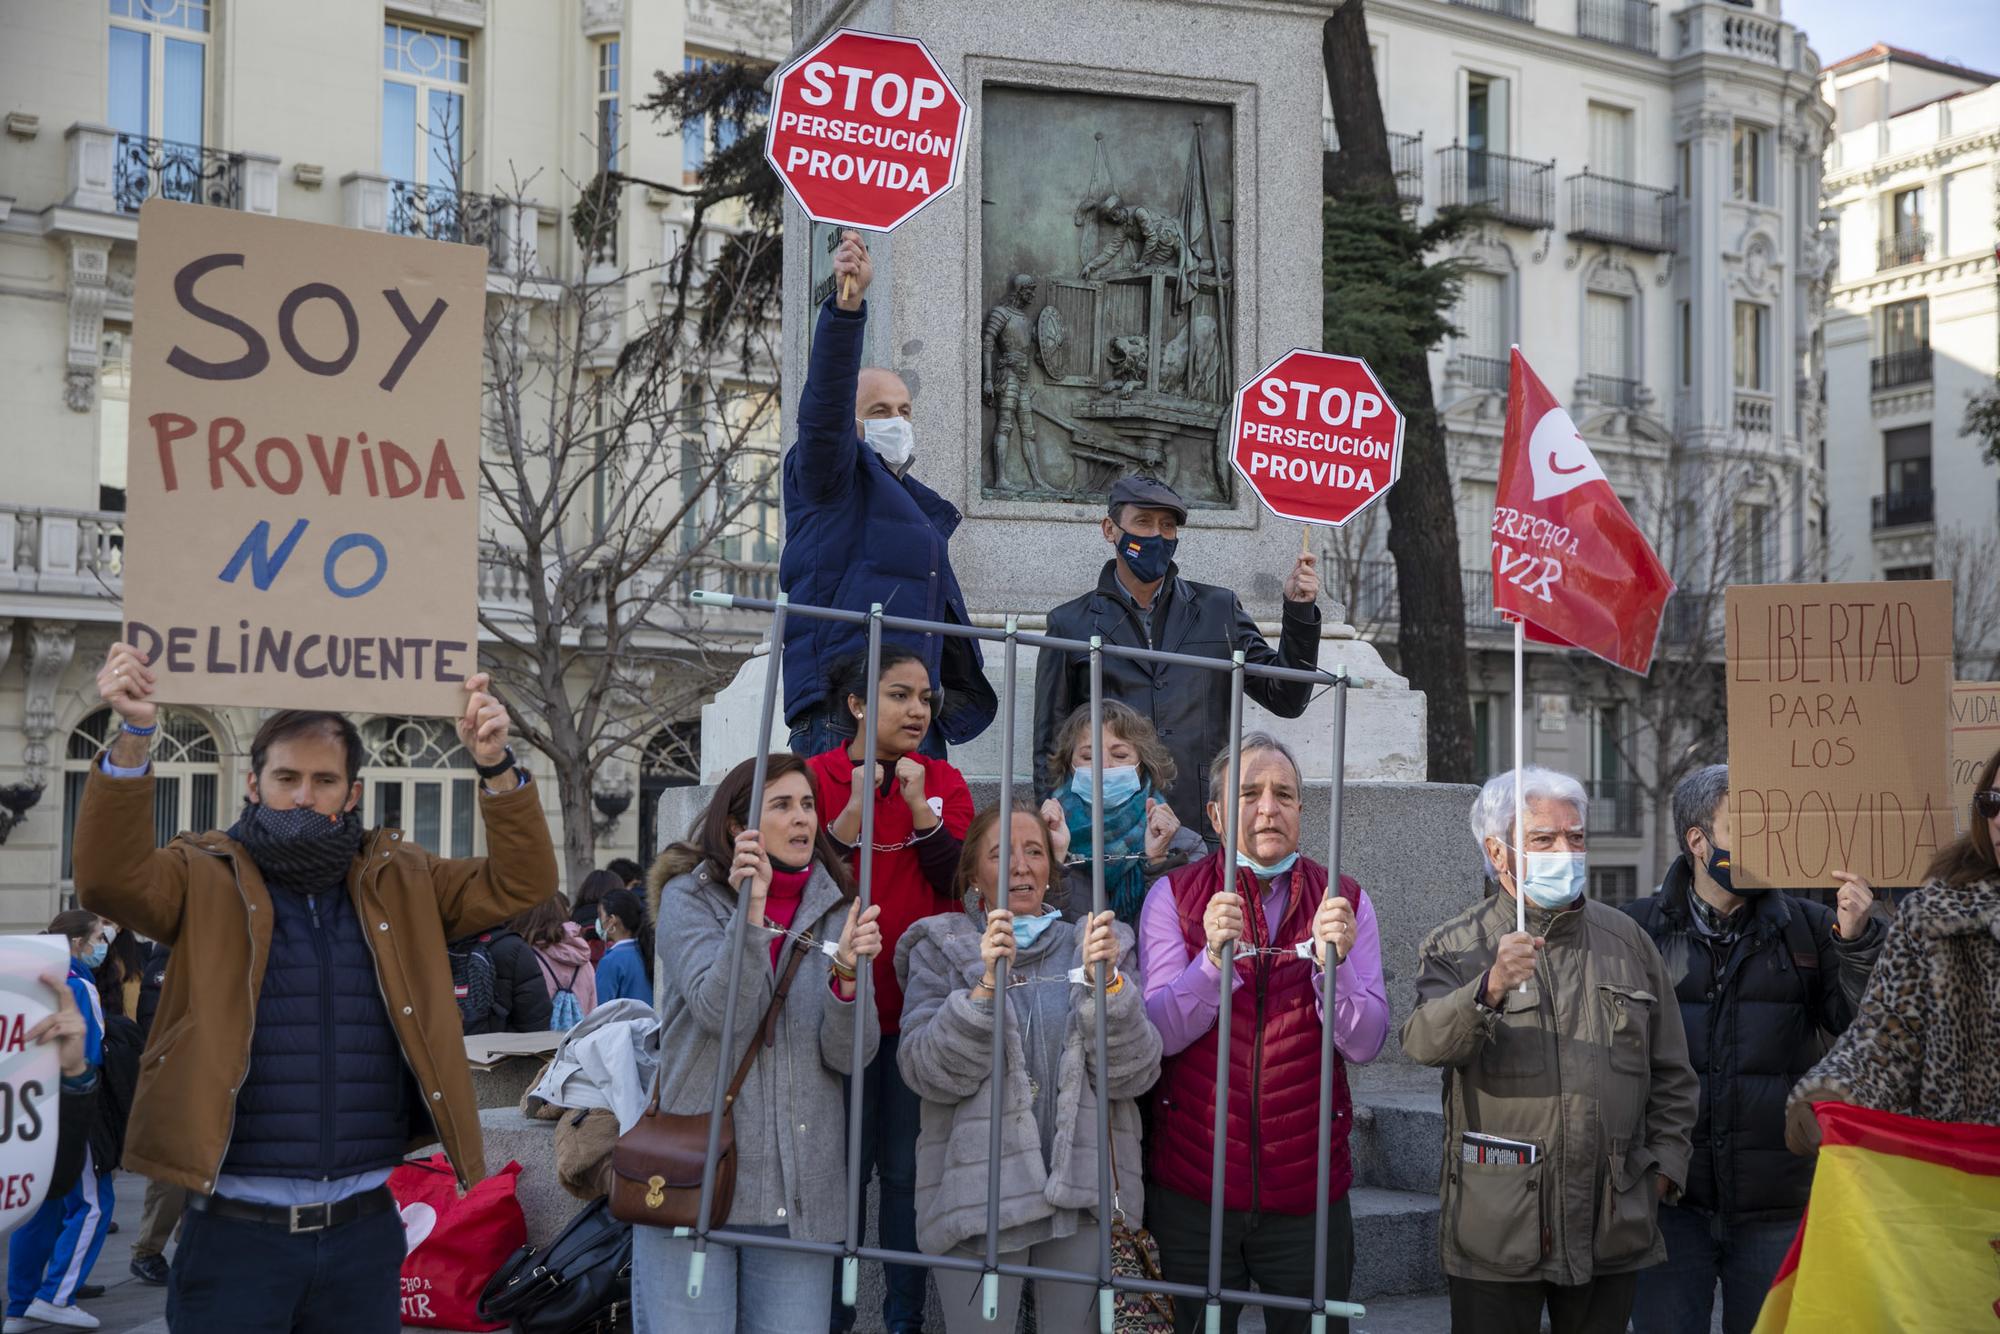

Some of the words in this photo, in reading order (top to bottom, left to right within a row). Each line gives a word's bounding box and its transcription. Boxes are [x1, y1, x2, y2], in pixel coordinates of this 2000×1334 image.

[800, 61, 945, 121] STOP
[780, 111, 951, 158] PERSECUCIÓN
[786, 146, 931, 195] PROVIDA
[166, 253, 449, 392] SOY
[1258, 377, 1383, 429] STOP
[1243, 421, 1391, 460] PERSECUCIÓN
[1250, 451, 1375, 493] PROVIDA
[218, 518, 389, 598] NO
[1565, 537, 1579, 556] A
[1735, 602, 1920, 684] LIBERTAD
[1769, 693, 1861, 728] PARA
[1791, 737, 1855, 768] LOS
[1738, 789, 1939, 880] PROVIDA
